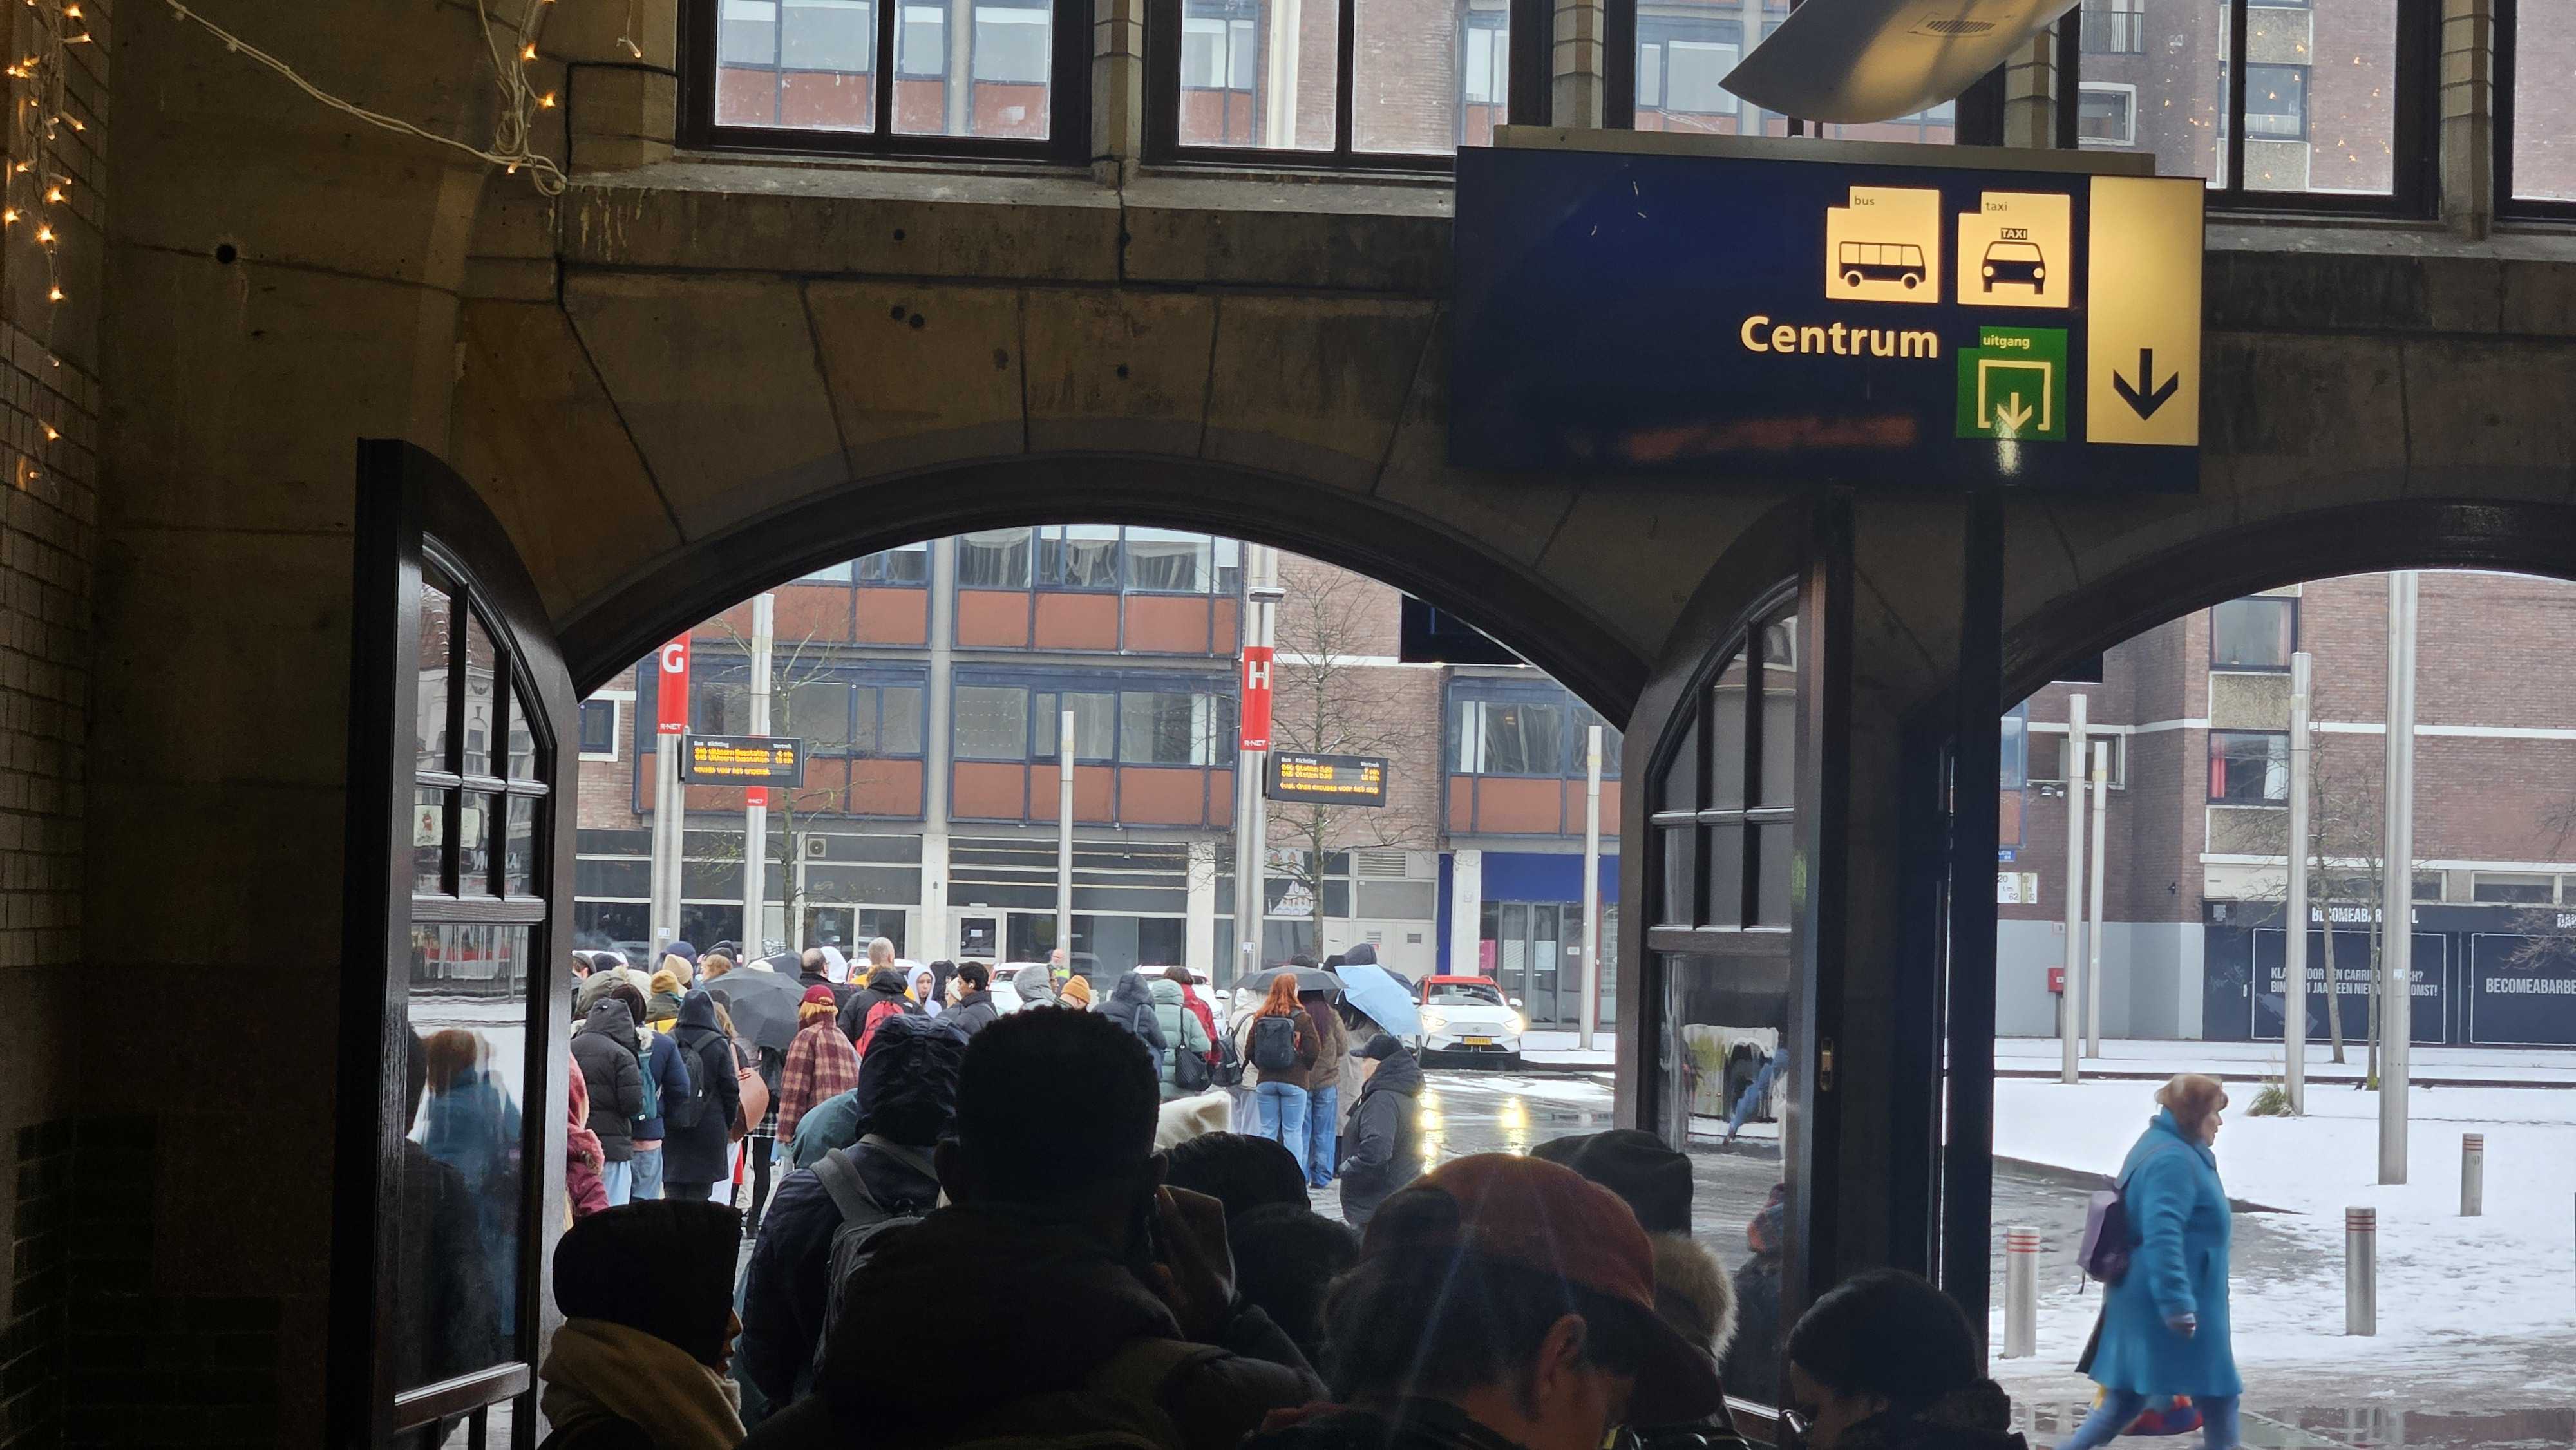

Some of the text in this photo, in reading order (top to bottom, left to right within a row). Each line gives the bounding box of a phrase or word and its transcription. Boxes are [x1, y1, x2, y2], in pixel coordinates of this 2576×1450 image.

[1855, 196, 1875, 206] bus
[1986, 202, 2007, 211] taxi
[2002, 229, 2027, 240] TAXI
[1740, 315, 1938, 358] Centrum
[1983, 335, 2031, 349] uitgang
[662, 644, 684, 673] G
[1249, 661, 1270, 689] H
